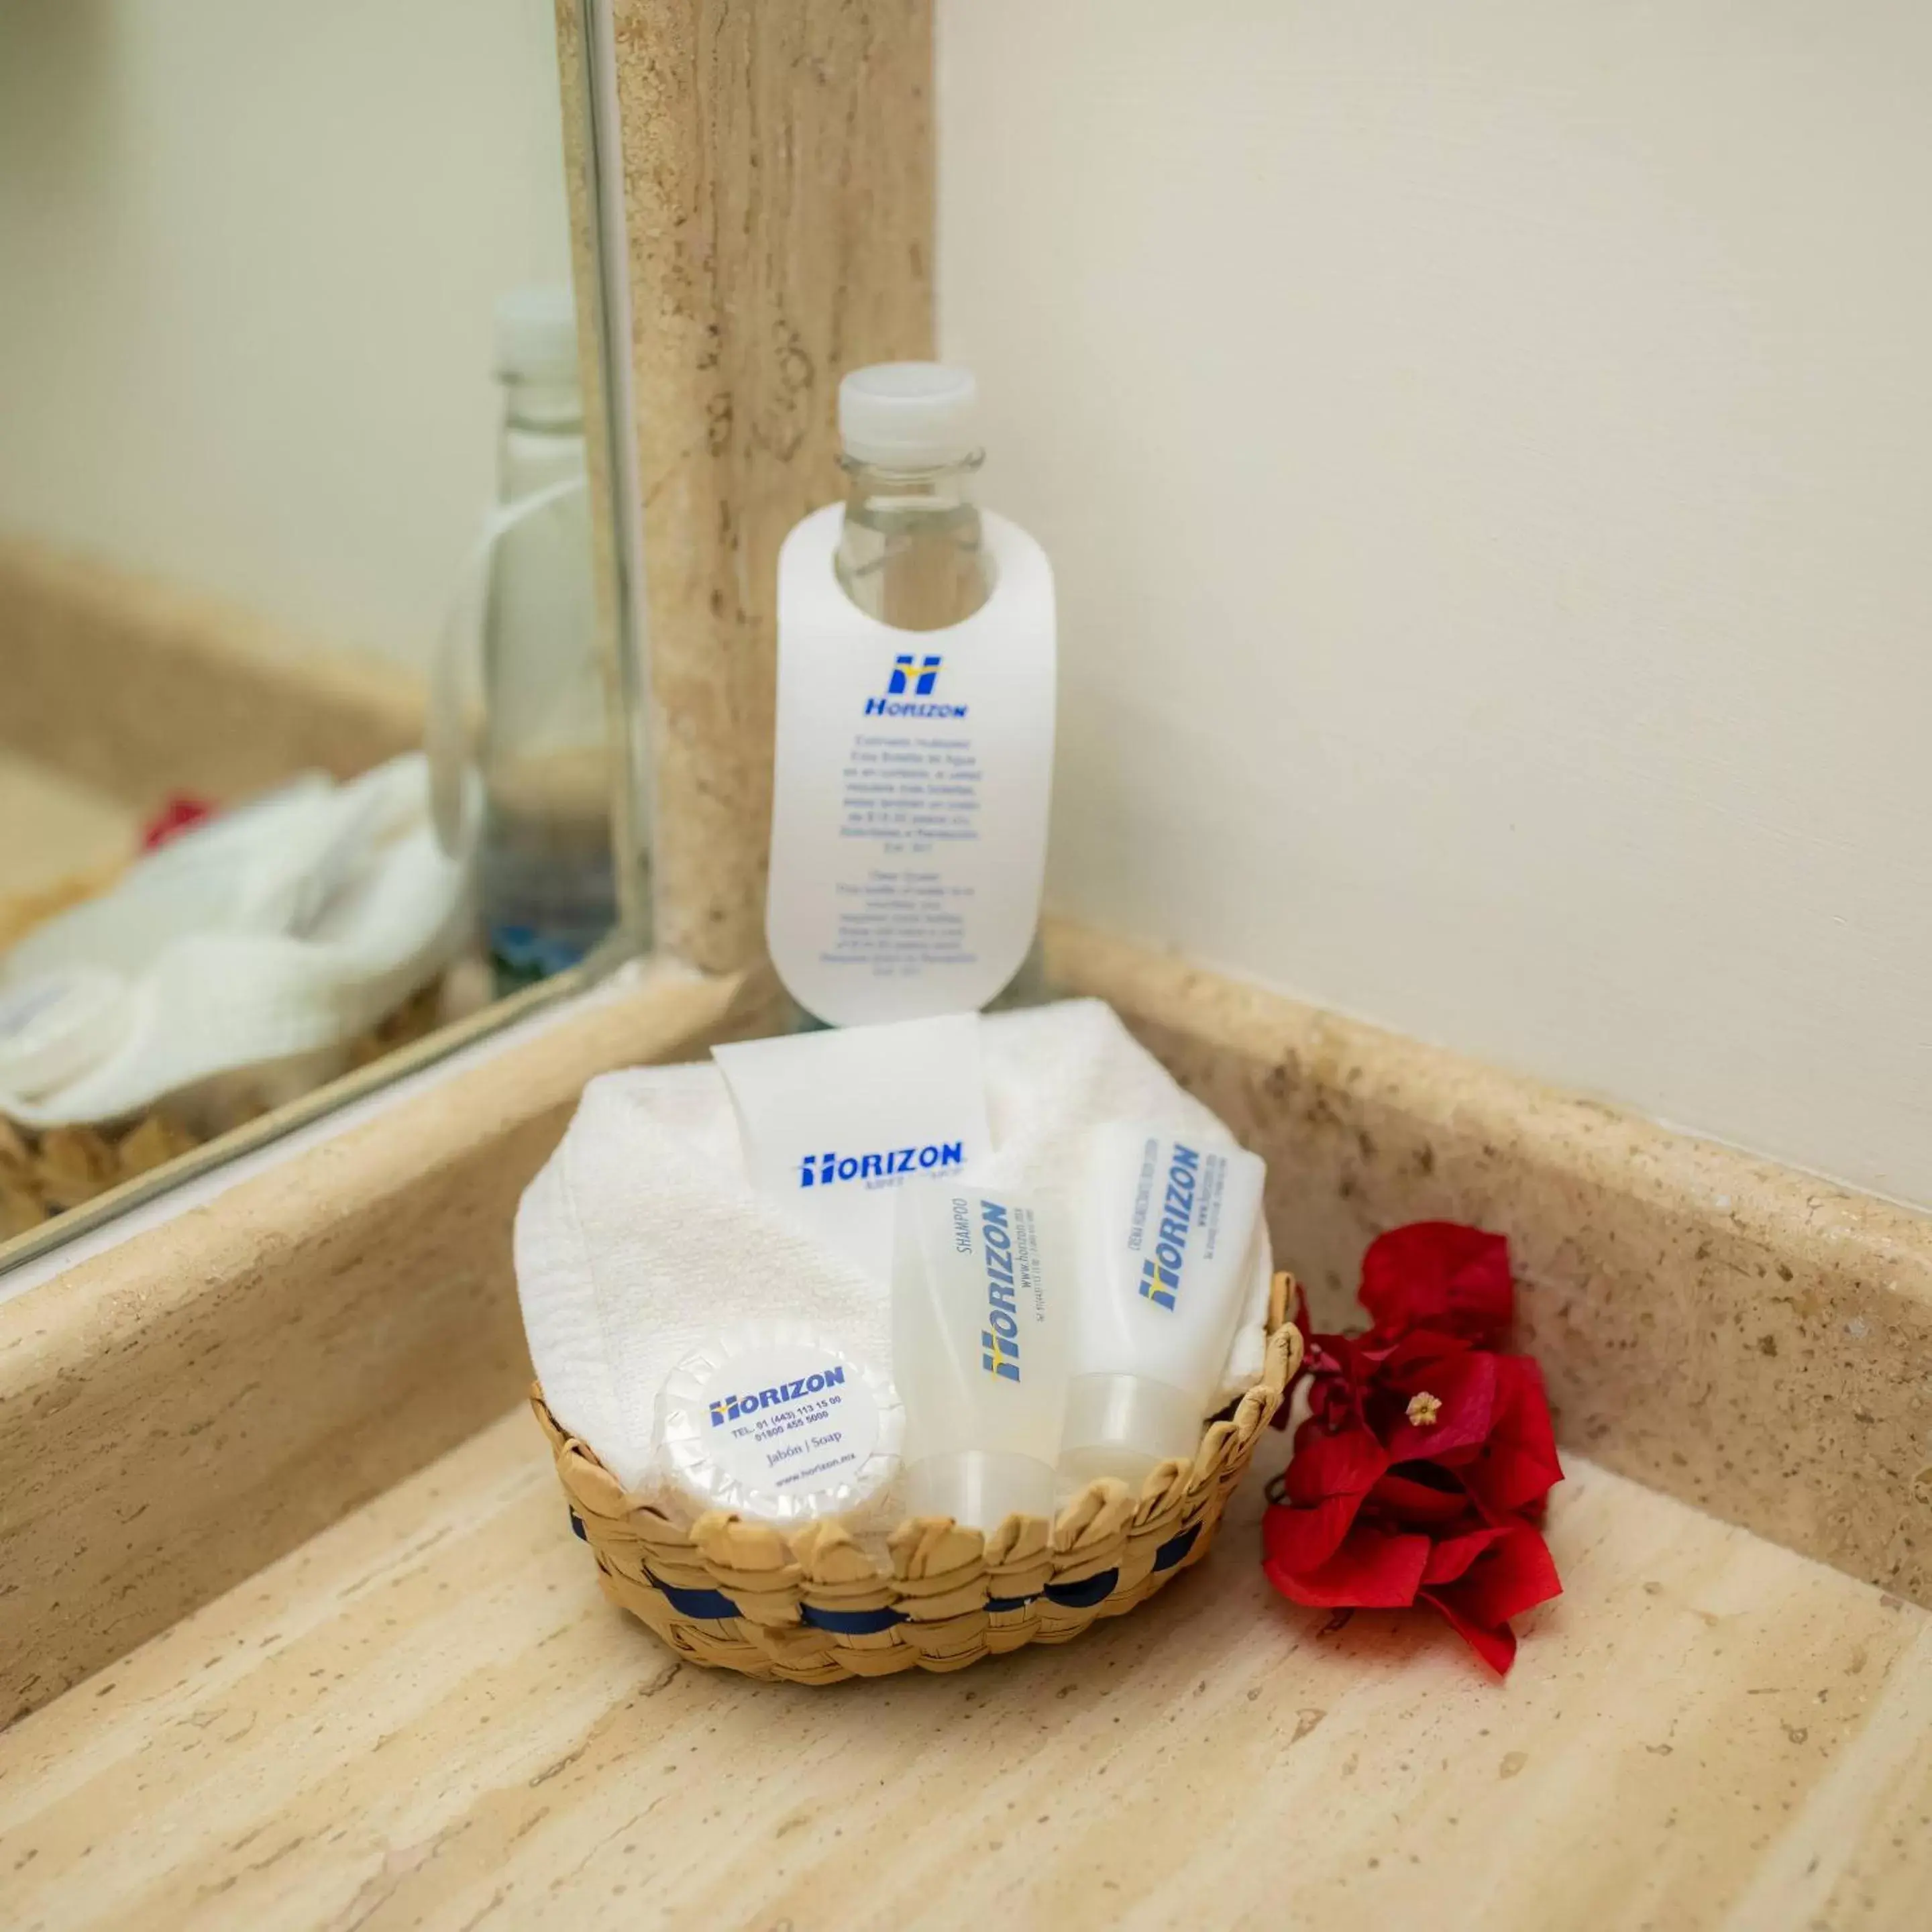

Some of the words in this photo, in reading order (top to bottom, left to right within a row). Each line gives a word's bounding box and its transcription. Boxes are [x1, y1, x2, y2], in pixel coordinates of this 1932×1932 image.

[865, 698, 968, 718] HORIZON
[800, 1142, 962, 1187] HORIZON
[953, 1198, 972, 1254] SHAMPOO
[1138, 1142, 1199, 1313] HORIZON
[980, 1200, 1020, 1383] HORIZON
[709, 1366, 845, 1427] HORIZON
[731, 1426, 755, 1439] TEL.
[756, 1419, 768, 1431] 01
[771, 1410, 796, 1426] (443)
[797, 1405, 814, 1416] 113
[816, 1399, 828, 1409] 15
[829, 1395, 842, 1405] 00
[755, 1426, 784, 1442] 01800
[787, 1418, 804, 1430] 455
[806, 1411, 829, 1424] 5000
[766, 1444, 802, 1468] Jabón
[811, 1432, 843, 1448] Soap
